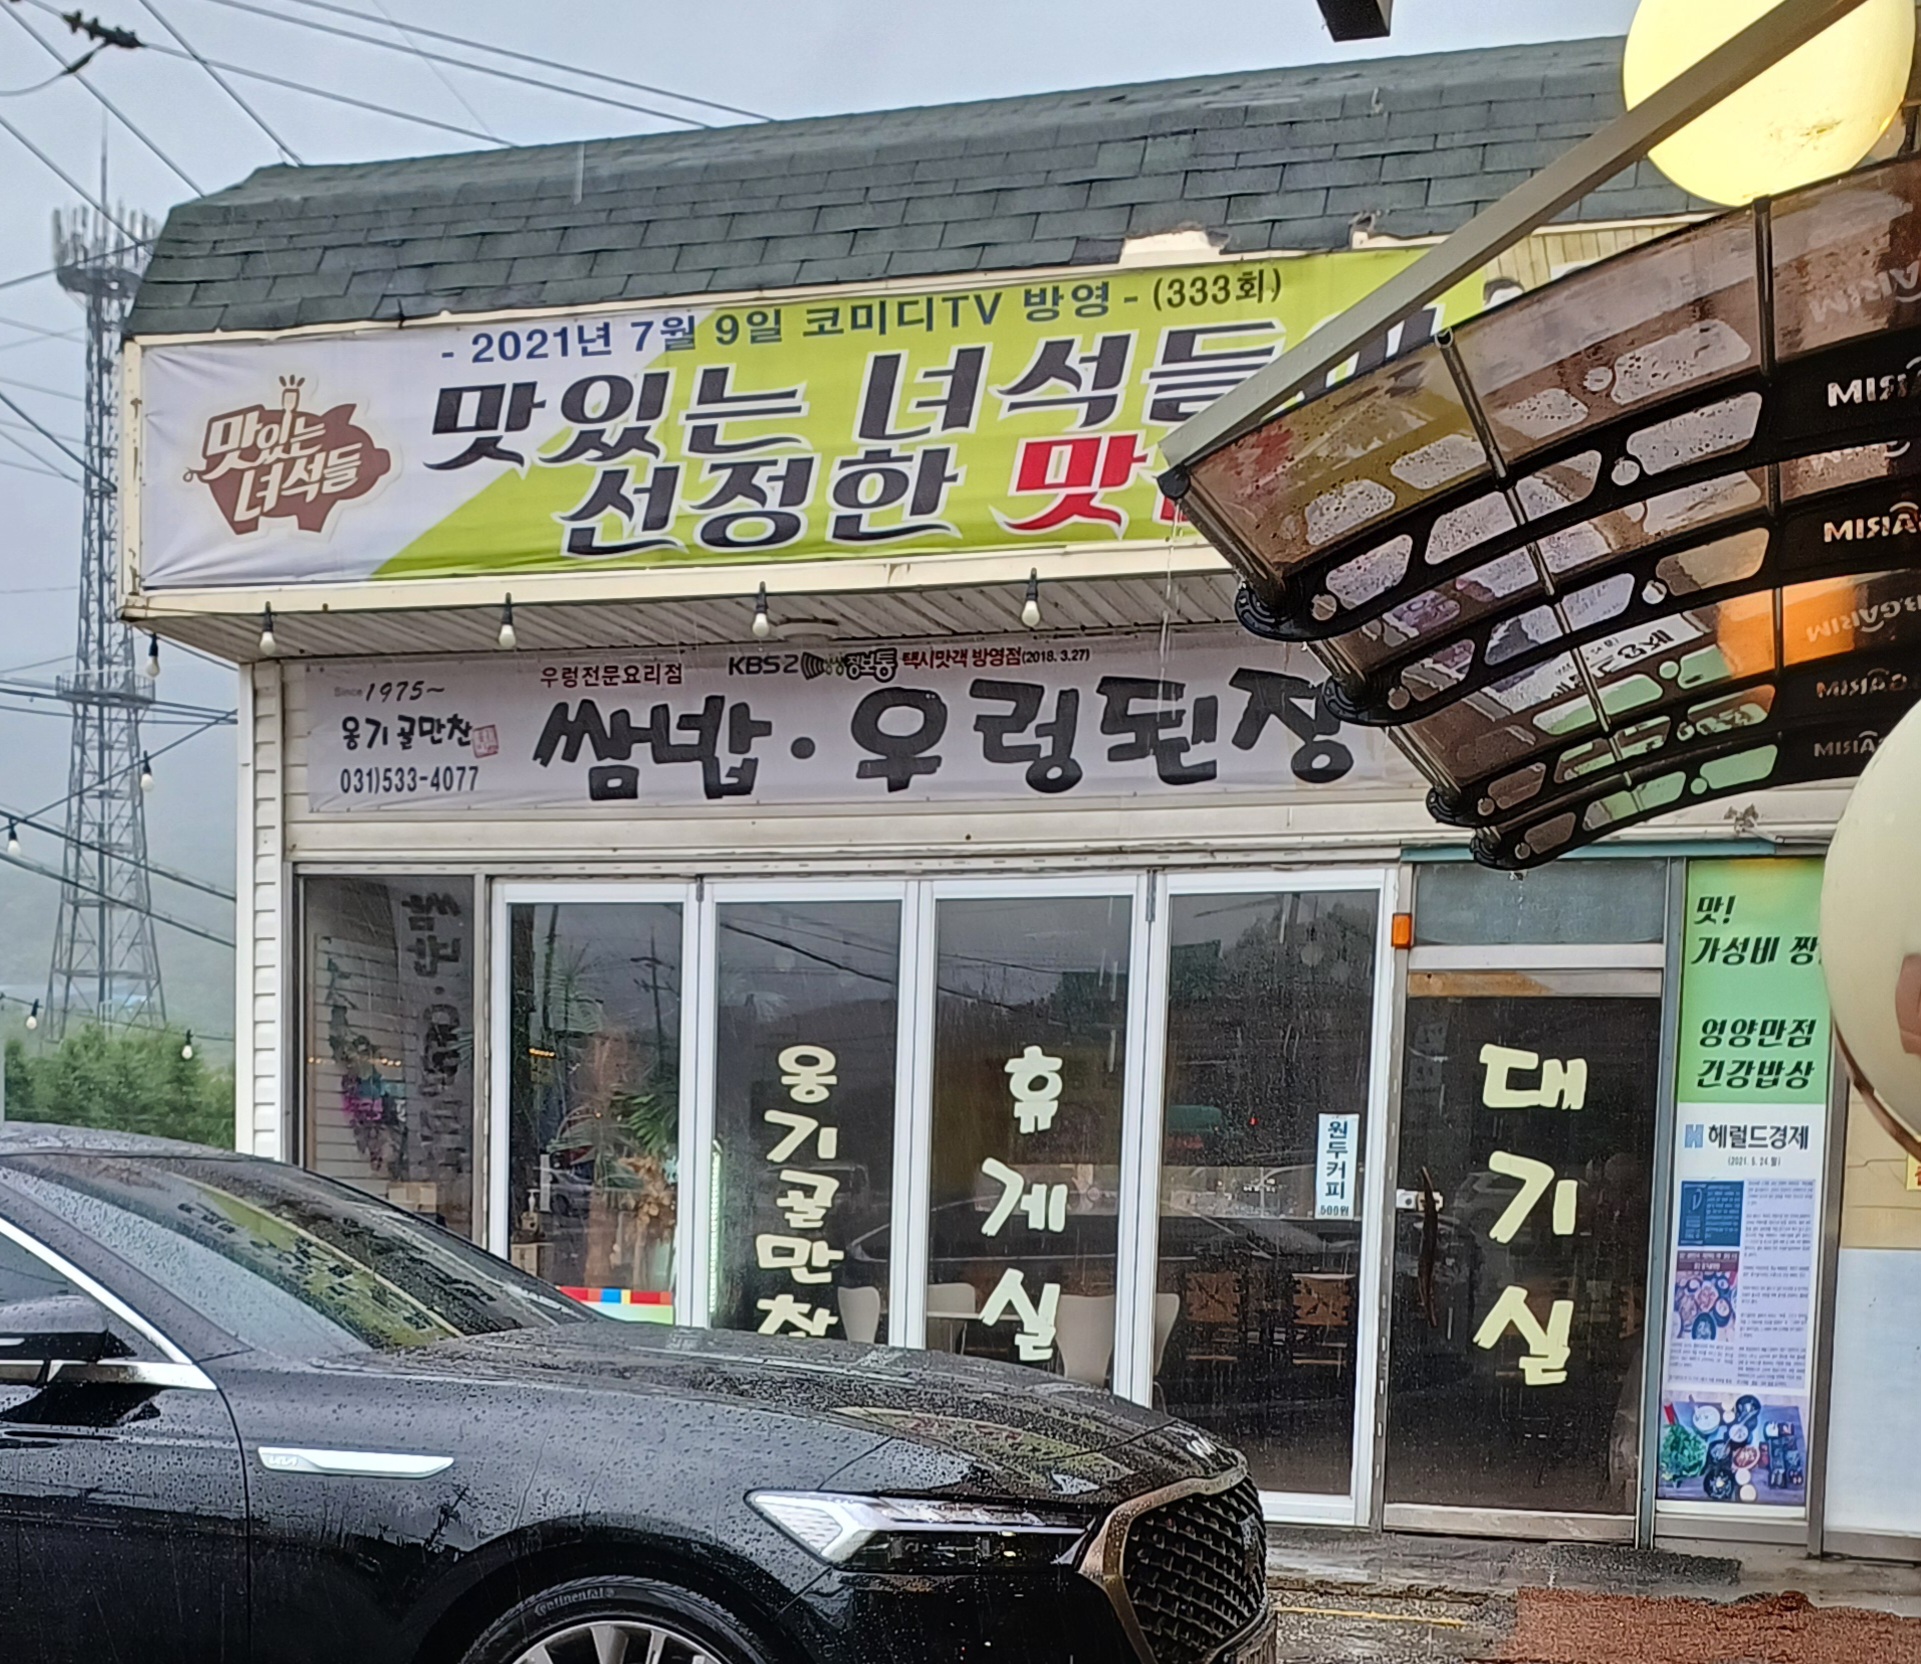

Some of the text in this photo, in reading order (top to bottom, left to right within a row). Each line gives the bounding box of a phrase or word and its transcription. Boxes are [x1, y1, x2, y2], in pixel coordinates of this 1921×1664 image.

[470, 320, 613, 364] 2021년
[630, 315, 697, 353] 7월
[715, 308, 783, 346] 9일
[803, 292, 1003, 339] 코미디TV
[1023, 281, 1111, 321] 방영
[1152, 266, 1283, 313] (333회)
[201, 411, 326, 480] 맛있는
[424, 366, 806, 470] 맛있는
[233, 442, 363, 521] 녀석들
[559, 434, 1188, 553] 선정한 맛
[540, 663, 684, 688] 우렁전문요리점
[902, 647, 968, 669] 택시맛객
[972, 646, 1021, 667] 방영점
[340, 765, 479, 794] 031)533-4077
[1694, 895, 1736, 925] 맛!
[1691, 936, 1780, 965] 가성비
[1699, 1018, 1816, 1048] 영양만점
[1697, 1060, 1814, 1089] 건강밥상
[1325, 1121, 1348, 1199] 원두커피
[1708, 1124, 1809, 1150] 헤럴드경제
[756, 1045, 844, 1338] 옹기골만찬
[979, 1045, 1068, 1361] 휴게실
[1473, 1044, 1588, 1385] 대기실
